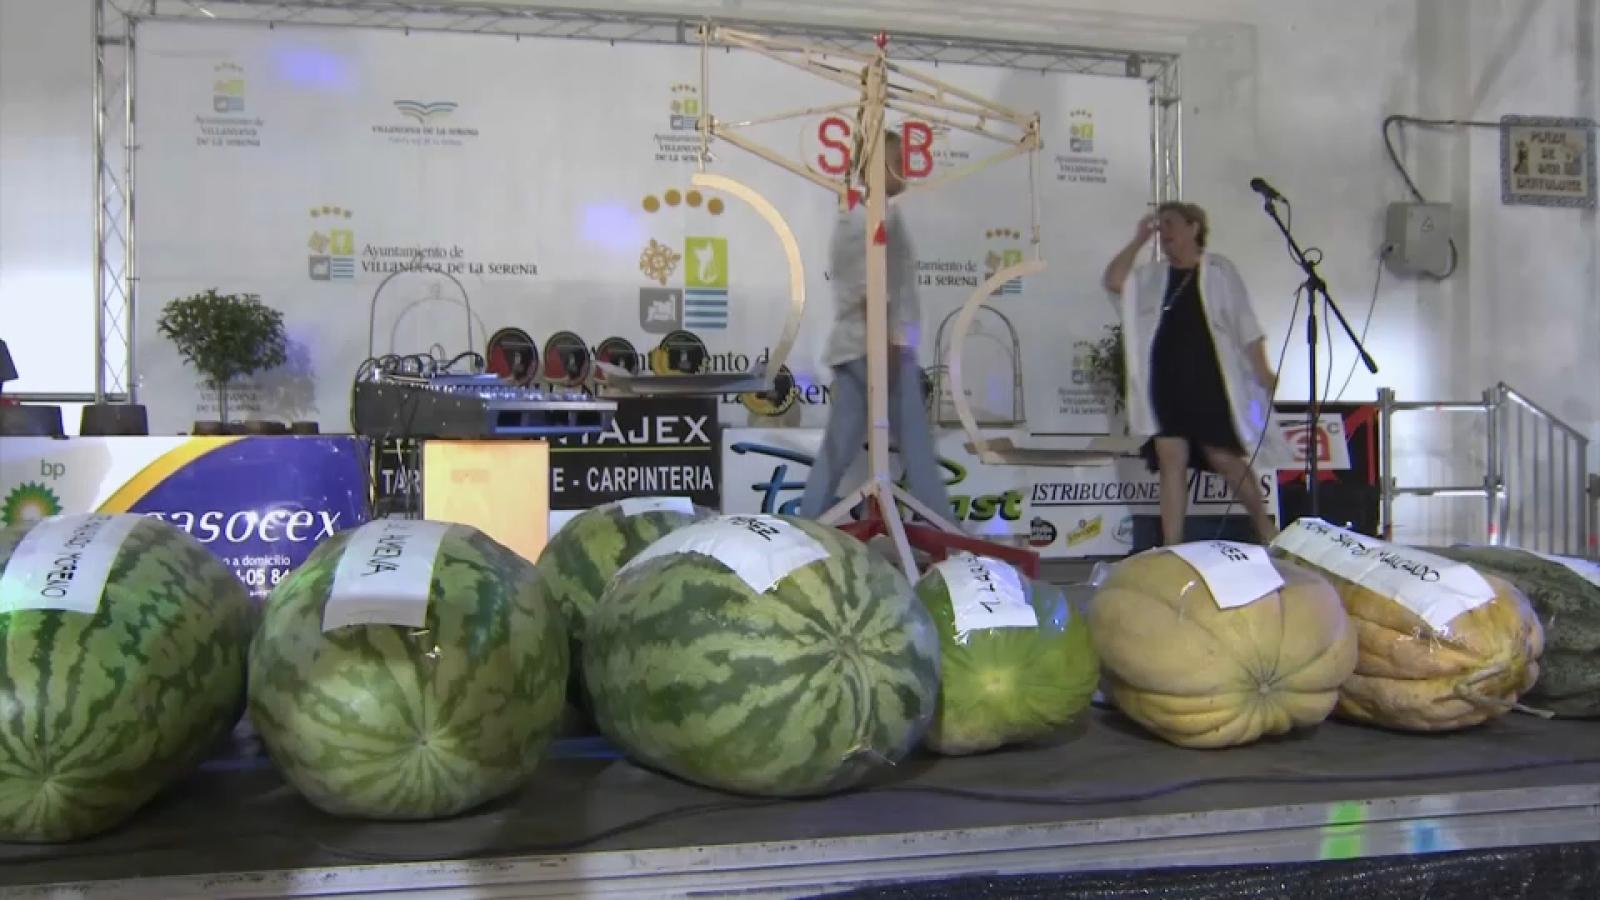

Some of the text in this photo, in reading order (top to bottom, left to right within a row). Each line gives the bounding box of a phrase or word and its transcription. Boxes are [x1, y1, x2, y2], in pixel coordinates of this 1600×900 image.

[818, 116, 933, 178] S B
[362, 243, 464, 260] Ayuntamiento de
[40, 459, 66, 479] bp
[587, 465, 715, 493] CARPINTERIA
[1031, 482, 1160, 502] ISTRIBUCIONE
[241, 554, 291, 566] domicilio
